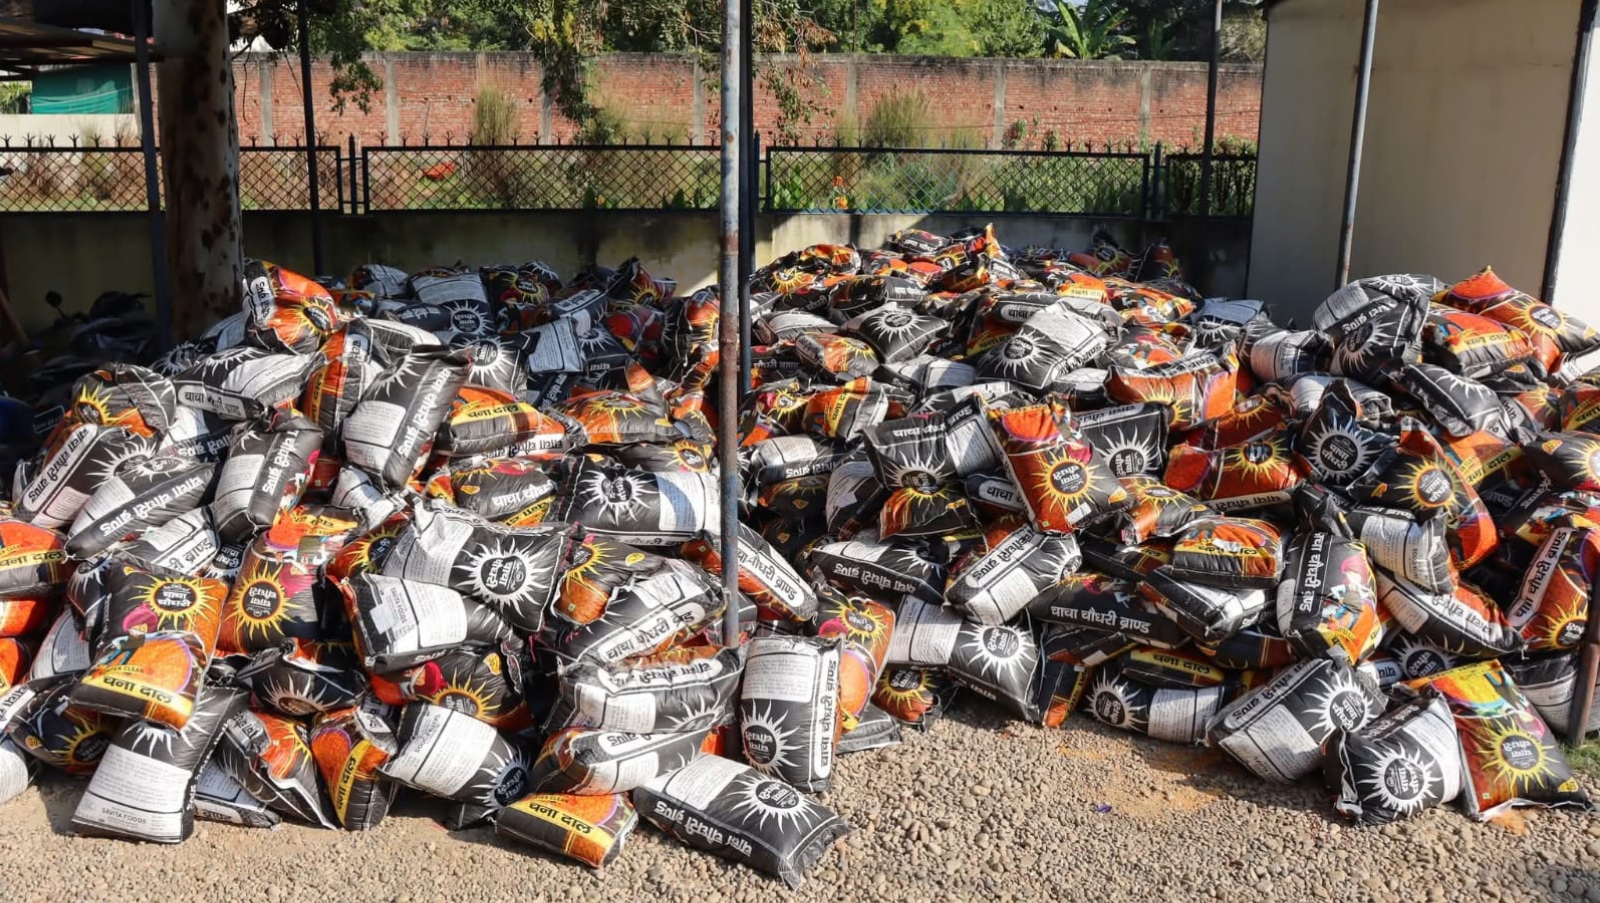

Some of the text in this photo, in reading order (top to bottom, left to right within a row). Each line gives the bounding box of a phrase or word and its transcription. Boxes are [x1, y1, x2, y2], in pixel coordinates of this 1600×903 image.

[1008, 308, 1029, 318] चाचा
[185, 391, 205, 404] चाचा
[1321, 450, 1349, 470] चौधरी
[1329, 444, 1350, 461] चाचा
[1488, 452, 1513, 470] दाल
[262, 462, 283, 496] ब्राण्ड
[1053, 465, 1080, 480] चौधरी
[1061, 473, 1080, 485] चाचा
[28, 478, 50, 503] ब्राण्ड
[492, 493, 520, 506] चाचा
[986, 485, 1013, 501] चाचा
[99, 475, 203, 537] चाचा चौधरी ब्राण्ड
[1217, 495, 1282, 512] चाचा चौधरी
[834, 563, 860, 578] ब्राण्ड
[971, 558, 998, 581] ब्राण्ड
[1305, 553, 1325, 588] चौधरी
[1530, 560, 1551, 594] चौधरी
[1547, 530, 1568, 559] ब्राण्ड
[485, 559, 503, 588] चौधरी
[499, 561, 514, 586] चाचा
[860, 568, 892, 592] चौधरी
[163, 591, 187, 600] चाचा
[249, 587, 277, 600] चौधरी
[774, 578, 799, 602] ब्राण्ड
[157, 597, 191, 607] चौधरी
[250, 597, 271, 607] चाचा
[1050, 605, 1151, 634] चाचा चौधरी ब्राण्ड
[1153, 653, 1211, 675] चना दाल
[102, 675, 174, 705] चना दाल
[820, 659, 837, 768] चाचा चौधरी ब्राण्ड
[1231, 695, 1261, 720] ब्राण्ड
[1332, 701, 1354, 730] चौधरी
[1342, 698, 1358, 721] चाचा
[748, 743, 770, 753] चाचा
[1502, 740, 1532, 752] चौधरी
[1511, 749, 1533, 758] चाचा
[123, 813, 147, 824] FOODS
[528, 801, 594, 835] चना दाल
[654, 800, 753, 856] चाचा चौधरी ब्राण्ड
